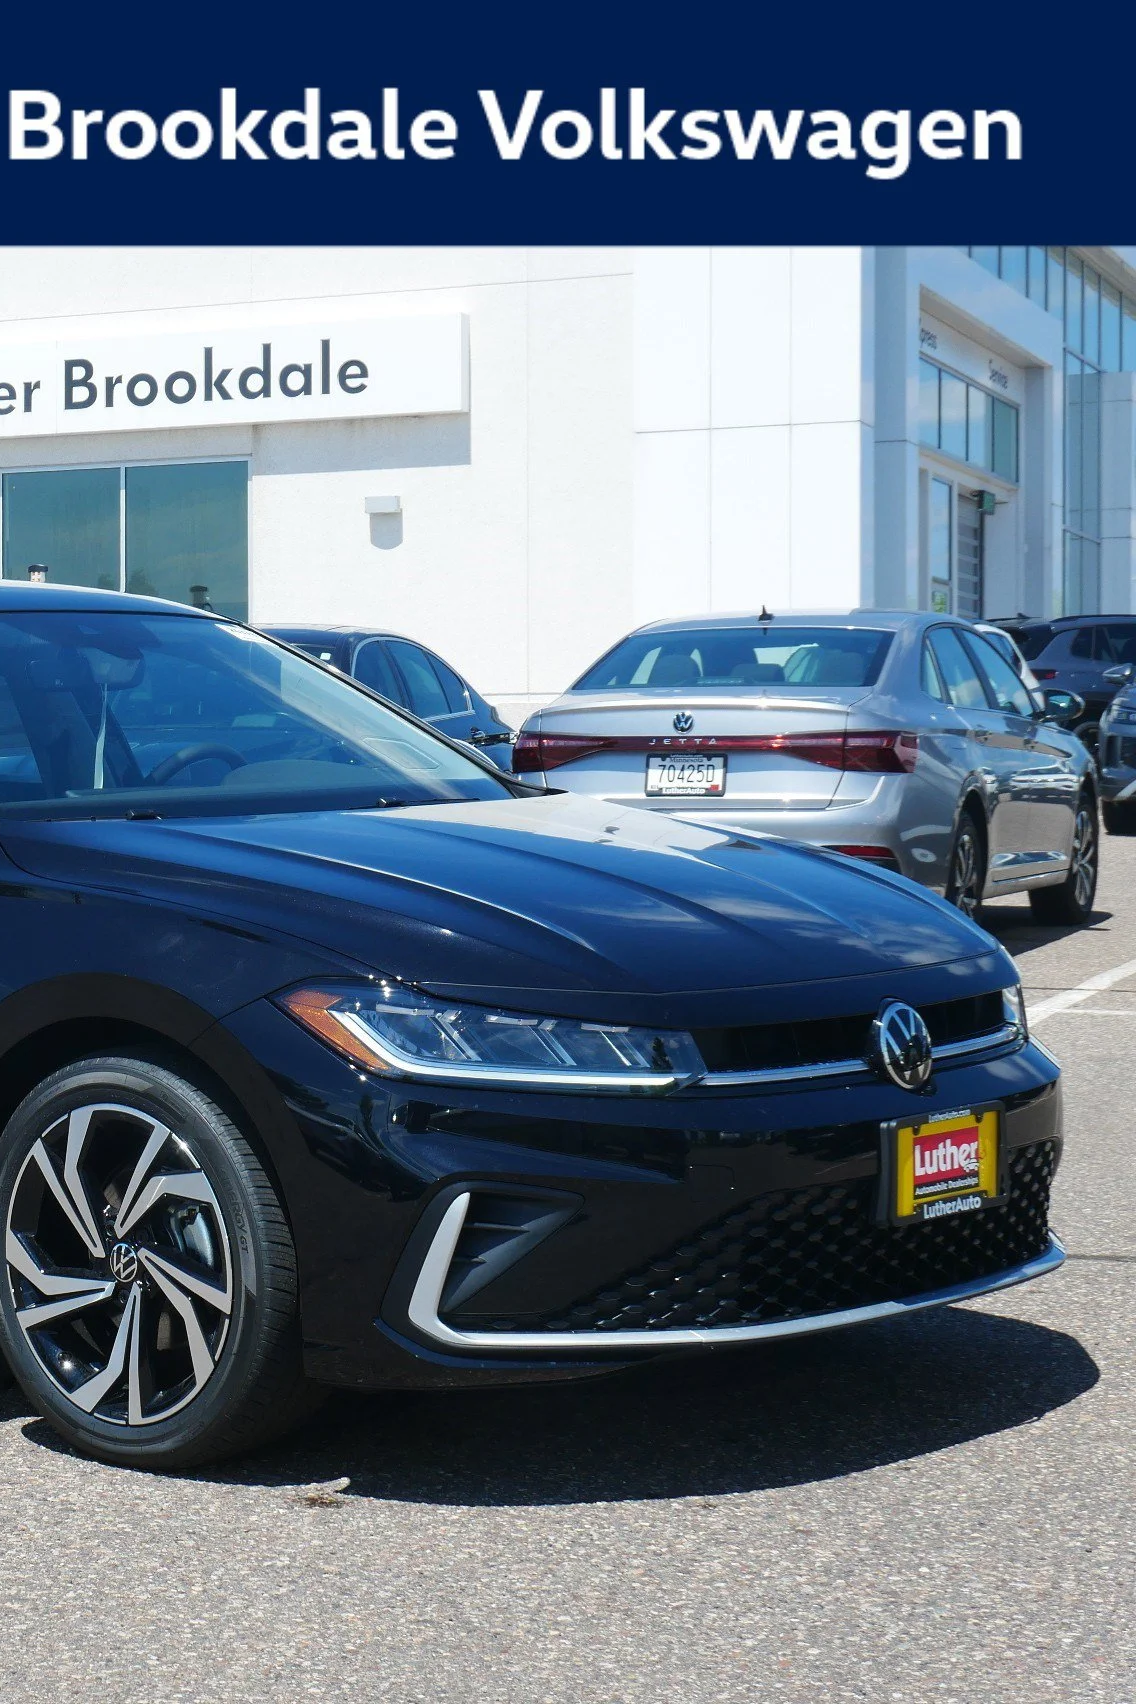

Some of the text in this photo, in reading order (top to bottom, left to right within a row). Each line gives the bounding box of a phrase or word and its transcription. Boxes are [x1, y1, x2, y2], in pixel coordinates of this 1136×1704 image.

[64, 339, 369, 411] Brookdale
[658, 764, 716, 784] 70425D
[914, 1138, 979, 1177] Luther
[924, 1195, 982, 1219] LutherAuto
